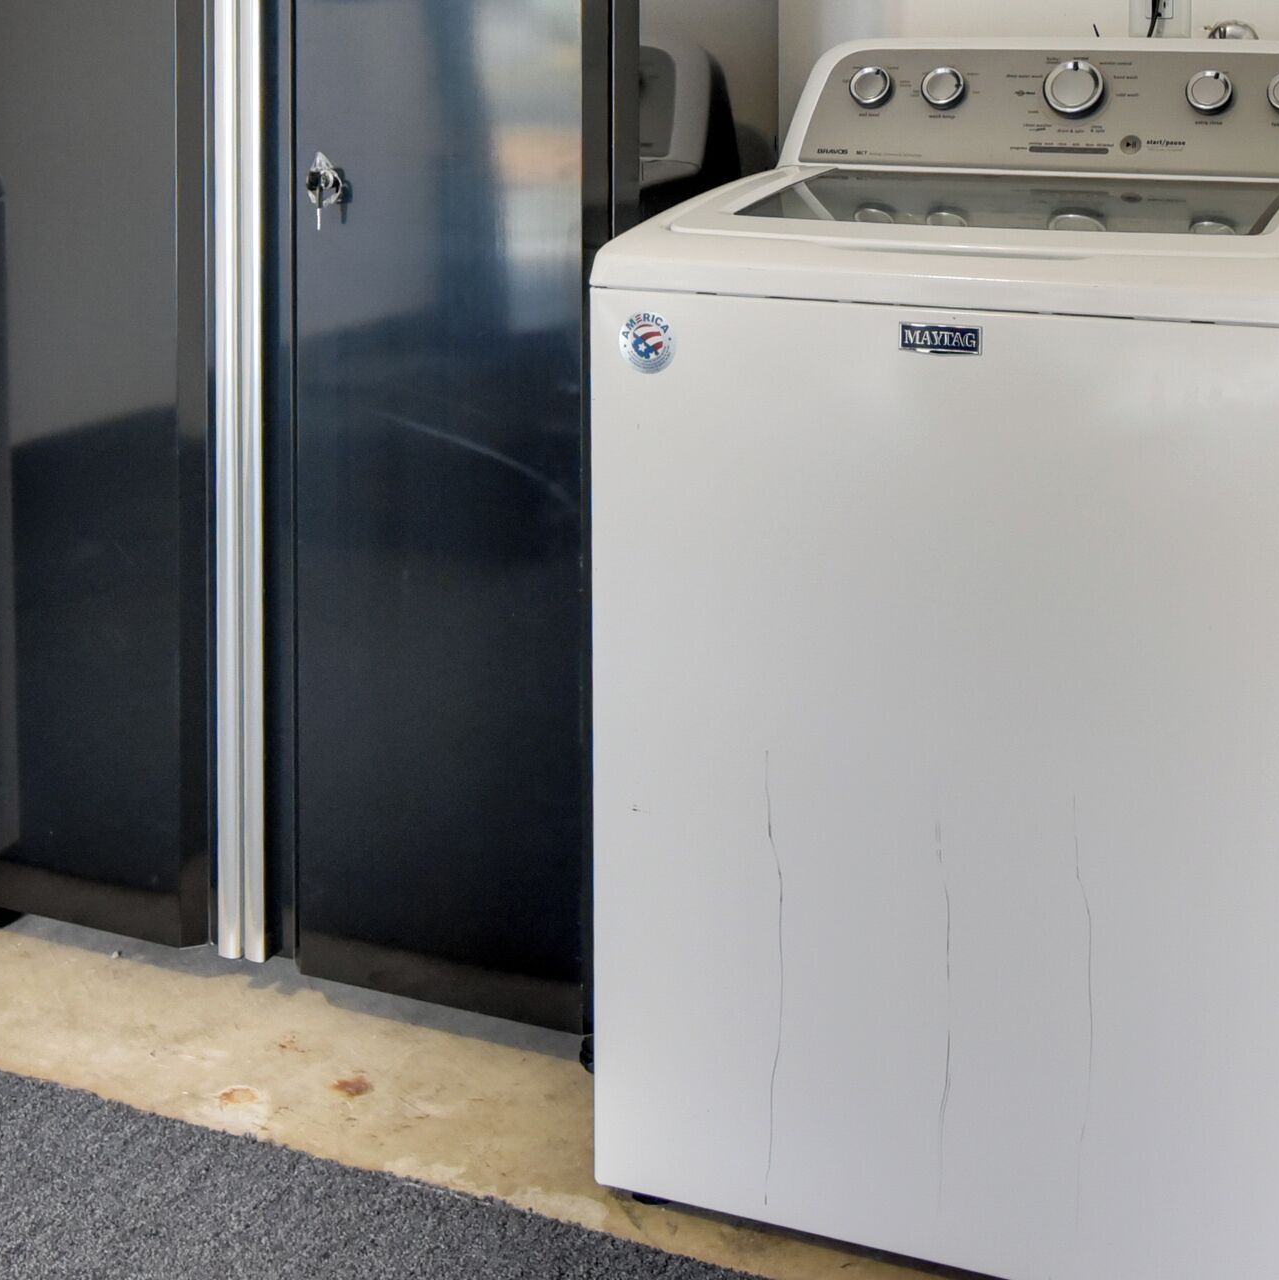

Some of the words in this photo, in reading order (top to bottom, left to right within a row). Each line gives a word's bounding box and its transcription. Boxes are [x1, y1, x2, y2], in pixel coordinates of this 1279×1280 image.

[1146, 139, 1186, 147] start/pause
[621, 312, 670, 340] AMERICA
[904, 329, 977, 348] MAYTAG
